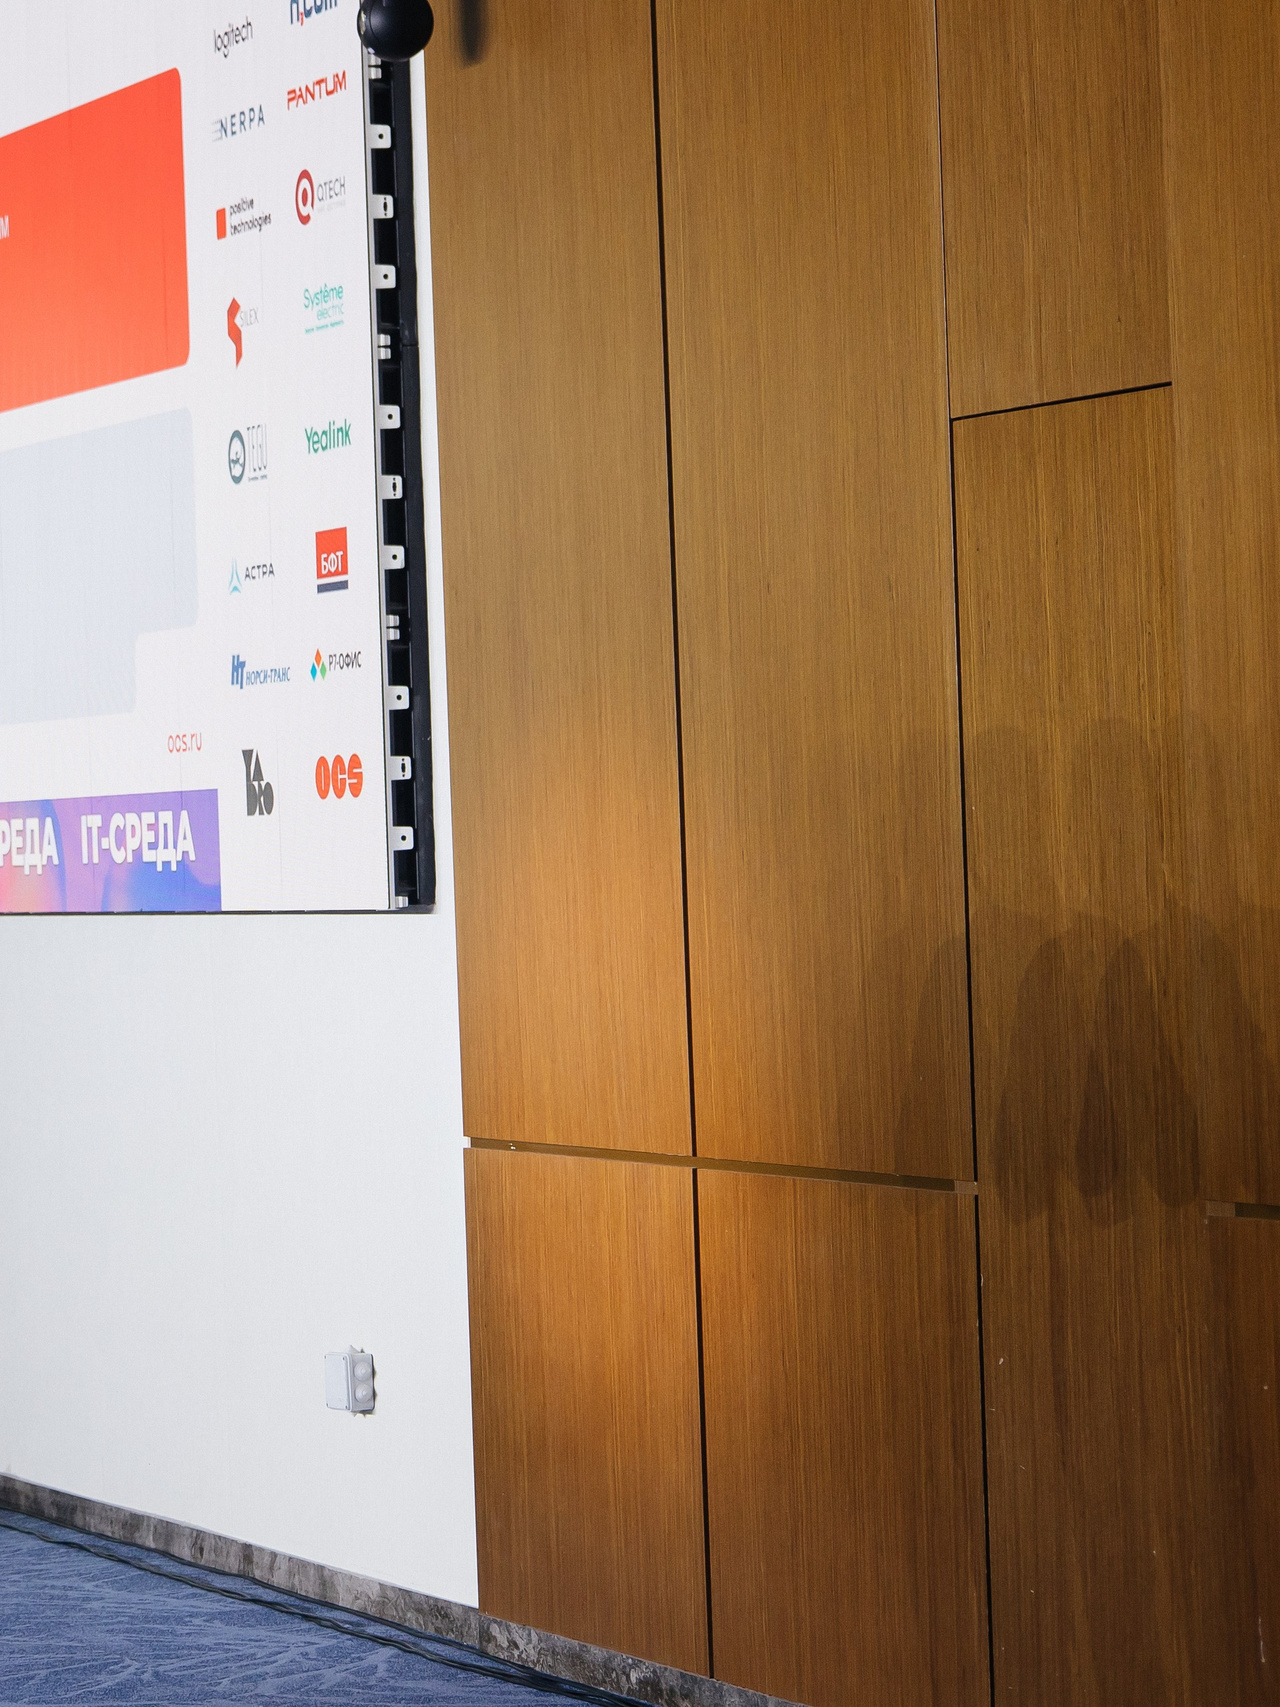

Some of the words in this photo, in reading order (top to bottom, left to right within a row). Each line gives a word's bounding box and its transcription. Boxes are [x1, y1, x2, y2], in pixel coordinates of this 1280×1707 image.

[214, 16, 253, 58] logitech
[287, 70, 347, 111] PANTUM
[219, 104, 266, 140] NERPA
[317, 176, 346, 202] QTECH
[229, 197, 254, 217] positive
[230, 212, 272, 236] technologies
[317, 303, 345, 321] electric
[305, 418, 352, 455] Yealink
[244, 563, 275, 581] АСТРА
[321, 551, 343, 575] БФТ
[329, 651, 362, 671] Р7-ОФИС
[246, 667, 291, 686] НОРСИ-ТРАНС
[167, 732, 203, 753] ocs.ru
[315, 753, 363, 800] OCS
[81, 809, 196, 872] IT-СРЕДА
